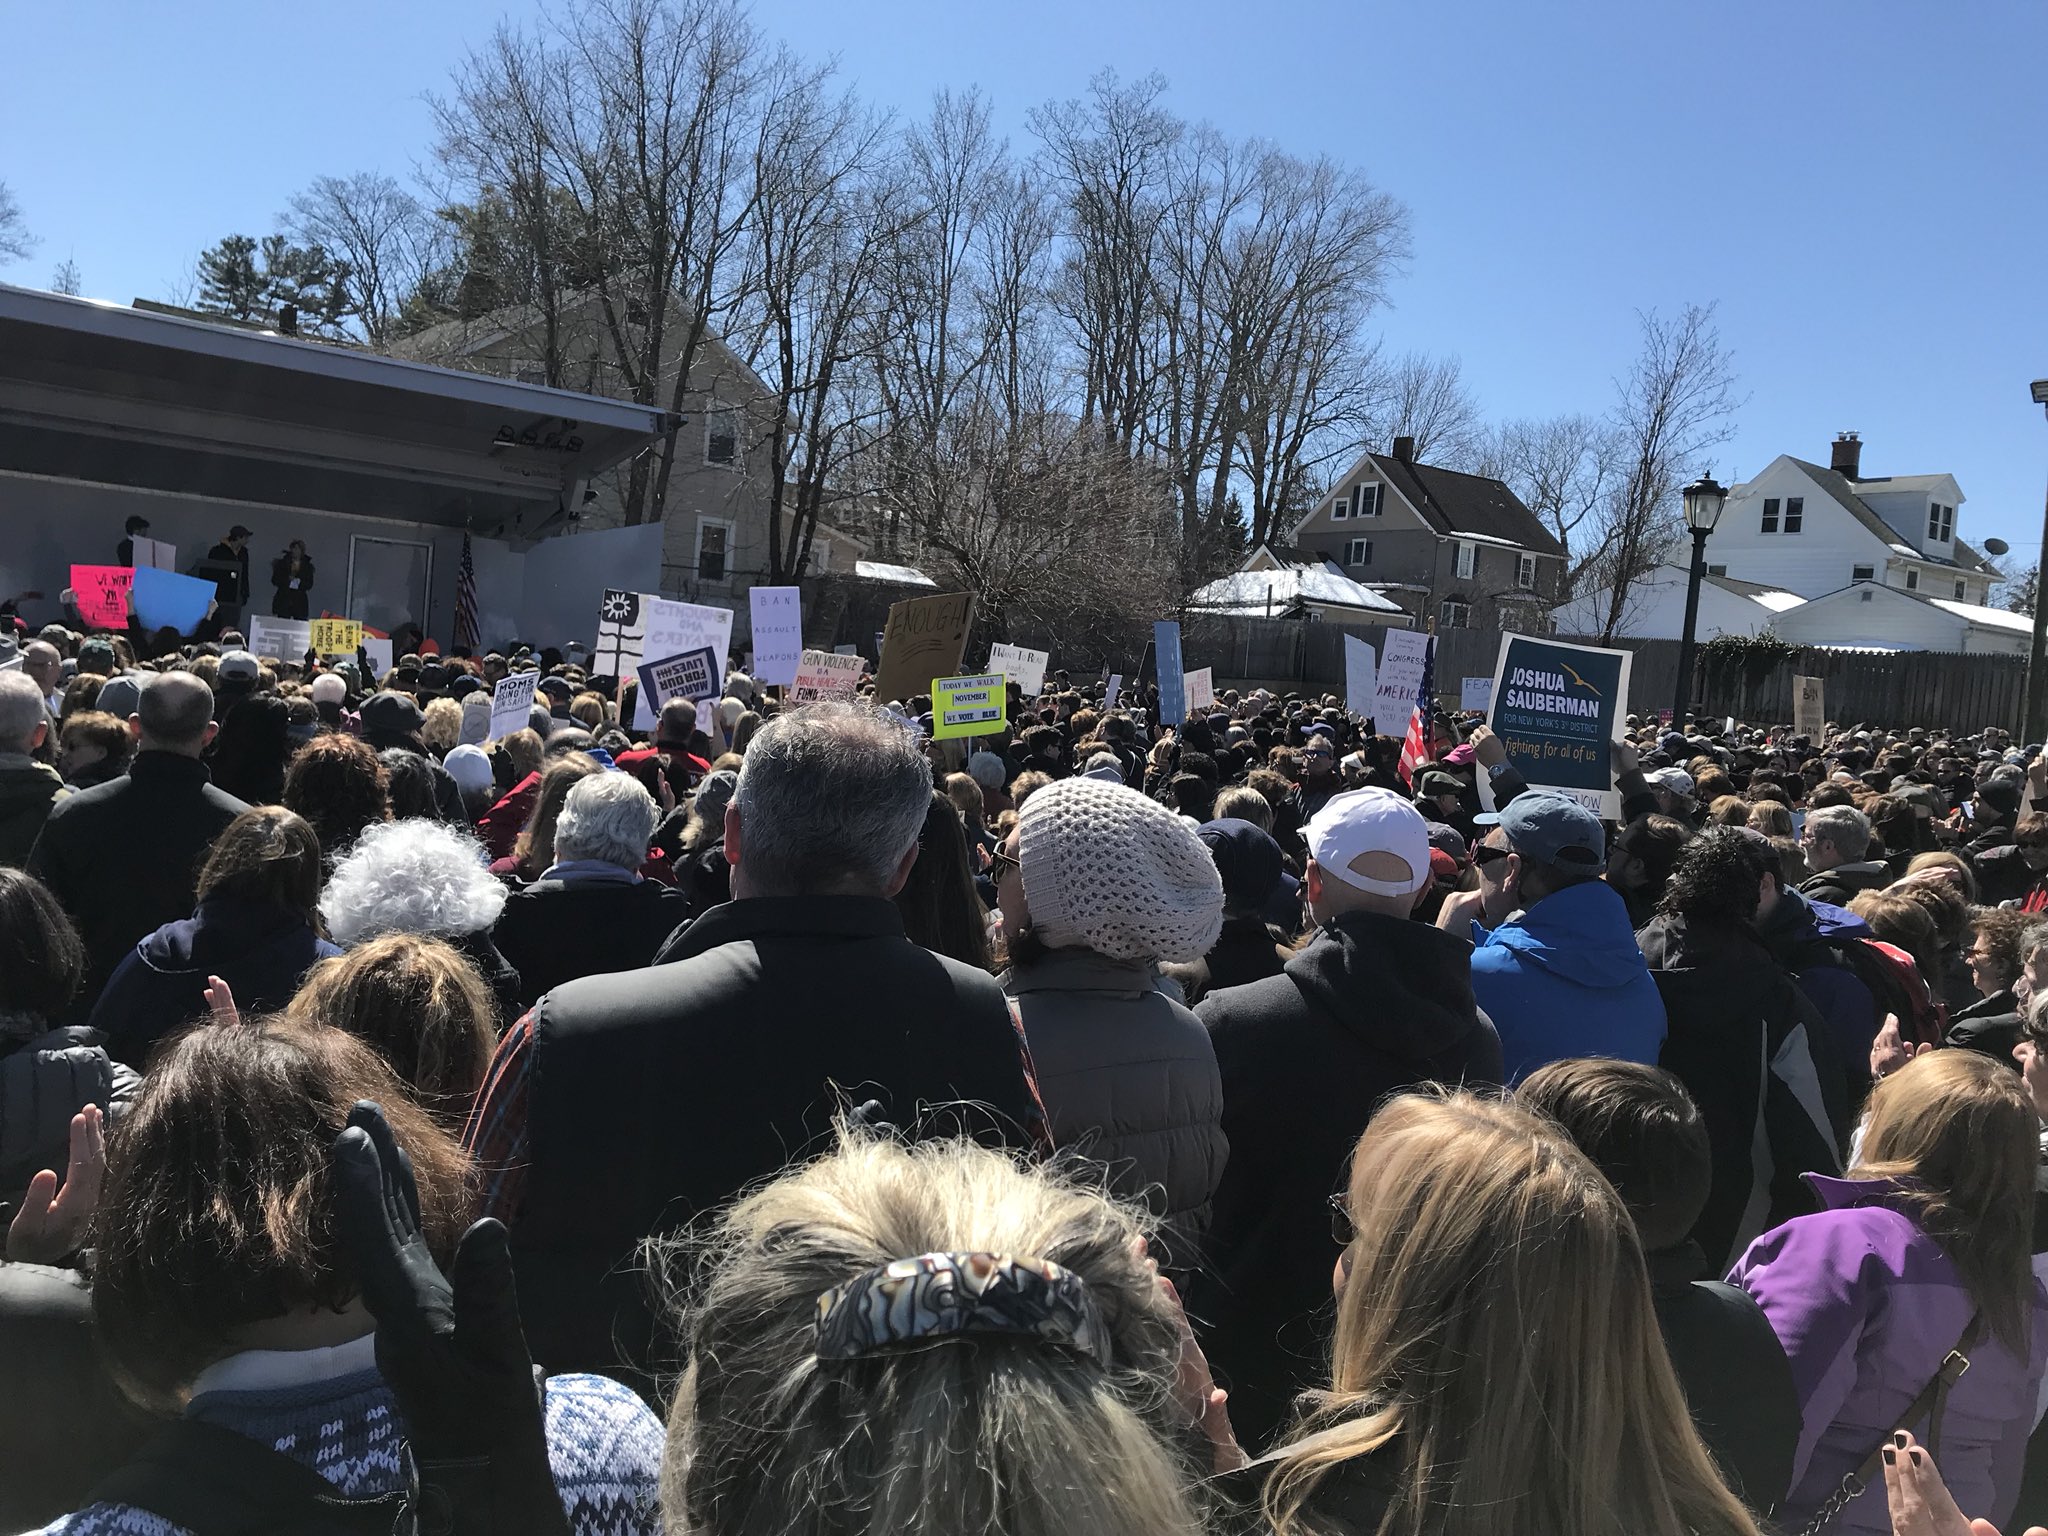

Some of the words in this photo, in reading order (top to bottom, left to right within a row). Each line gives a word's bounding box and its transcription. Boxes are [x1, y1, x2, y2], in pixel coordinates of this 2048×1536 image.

[760, 597, 790, 606] BAN
[890, 597, 970, 640] ENOUGH!
[335, 629, 343, 645] THE
[756, 653, 798, 662] WEAPONS
[803, 653, 821, 666] GUN
[823, 655, 858, 671] VIOLENCE
[1387, 652, 1426, 666] CONGRESS
[659, 675, 684, 691] OUR
[684, 669, 707, 684] FOR
[943, 679, 961, 690] TODAY
[976, 678, 994, 687] WALK
[1510, 666, 1565, 692] JOSHUA
[499, 678, 534, 693] MOMS
[1377, 685, 1419, 700] AMERIC
[955, 692, 987, 701] NOVEMBER
[1506, 689, 1599, 718] SAUBERMAN
[946, 714, 956, 722] WE
[958, 712, 974, 721] VOTE
[982, 710, 997, 719] BLUE
[1504, 713, 1517, 724] FOR
[1518, 715, 1534, 726] NEW
[1536, 717, 1559, 729] YORK'S
[1570, 722, 1598, 734] DISTRICT
[1504, 736, 1541, 760] fighting
[1543, 741, 1559, 760] for
[1560, 743, 1571, 758] all
[1573, 746, 1585, 763] of
[1586, 749, 1596, 761] us
